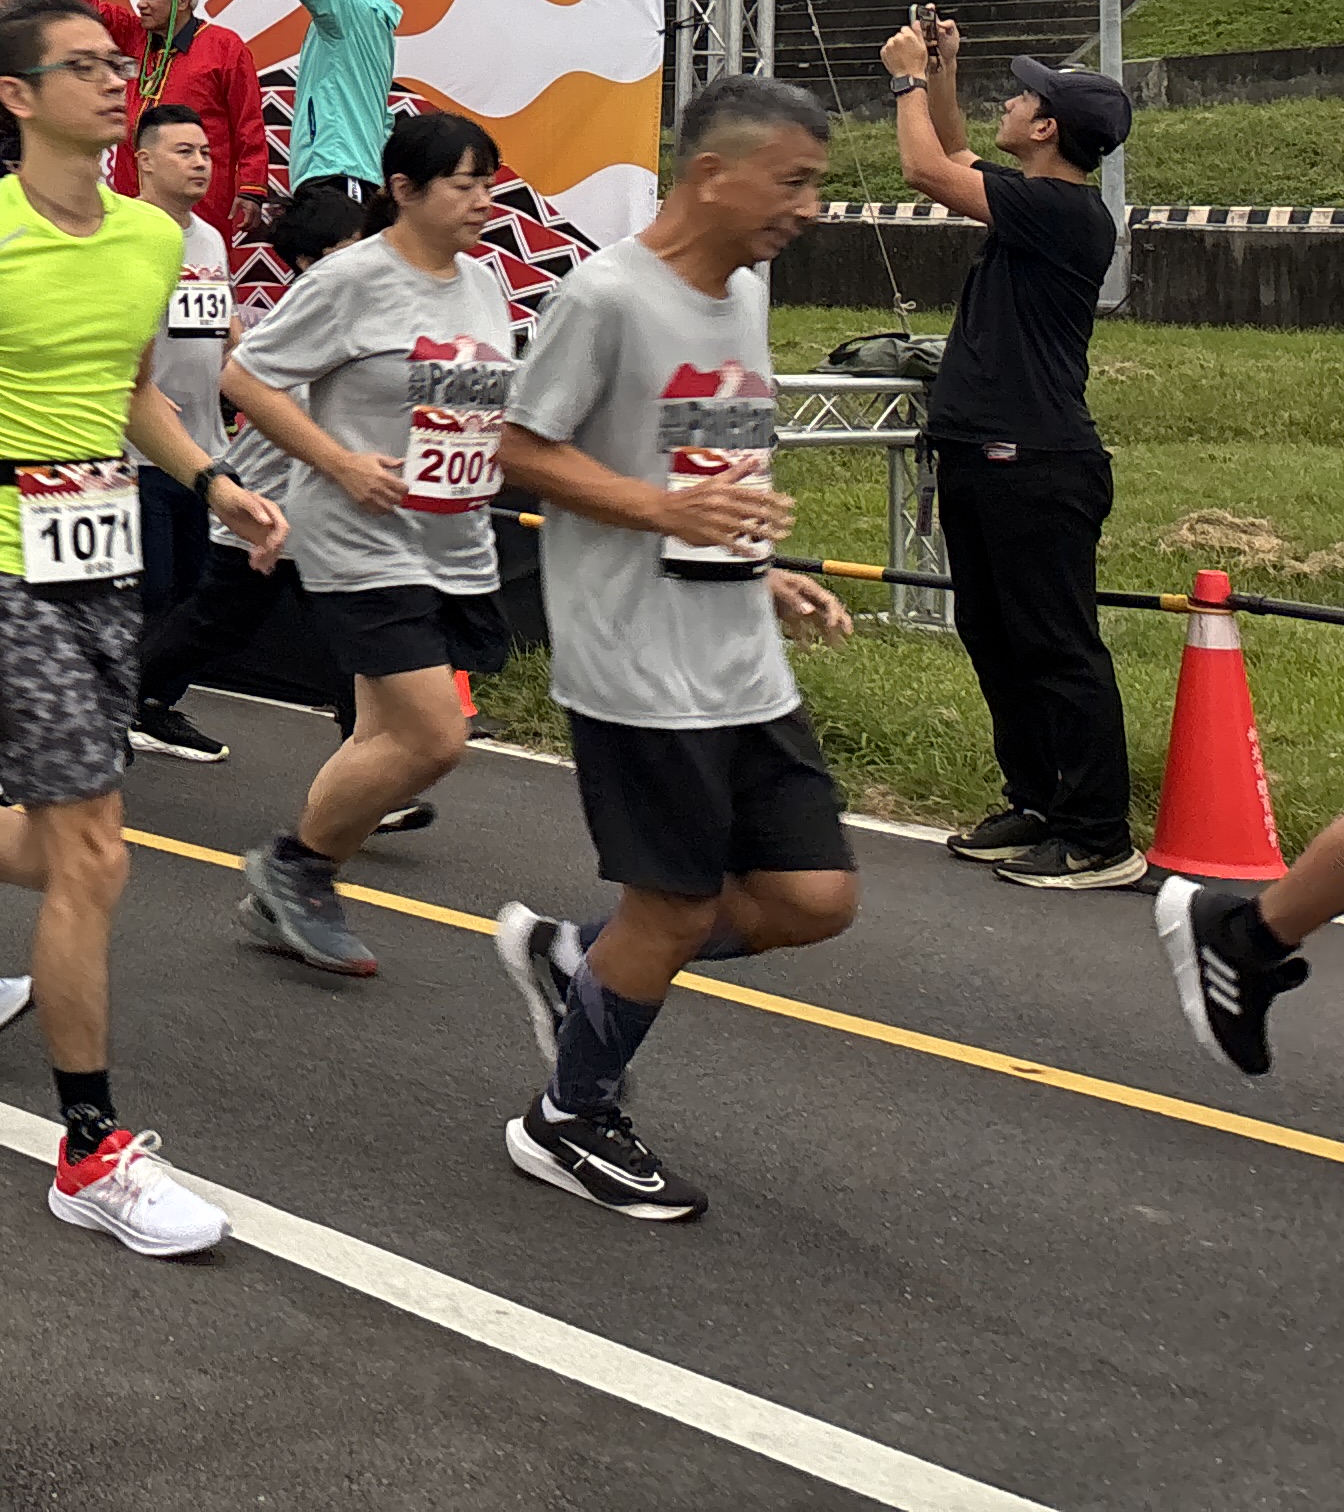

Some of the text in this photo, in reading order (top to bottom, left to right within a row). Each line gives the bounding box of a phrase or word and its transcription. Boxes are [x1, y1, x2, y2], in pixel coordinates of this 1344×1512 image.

[178, 293, 226, 318] 1131
[417, 449, 498, 484] 2001
[40, 510, 133, 562] 1071
